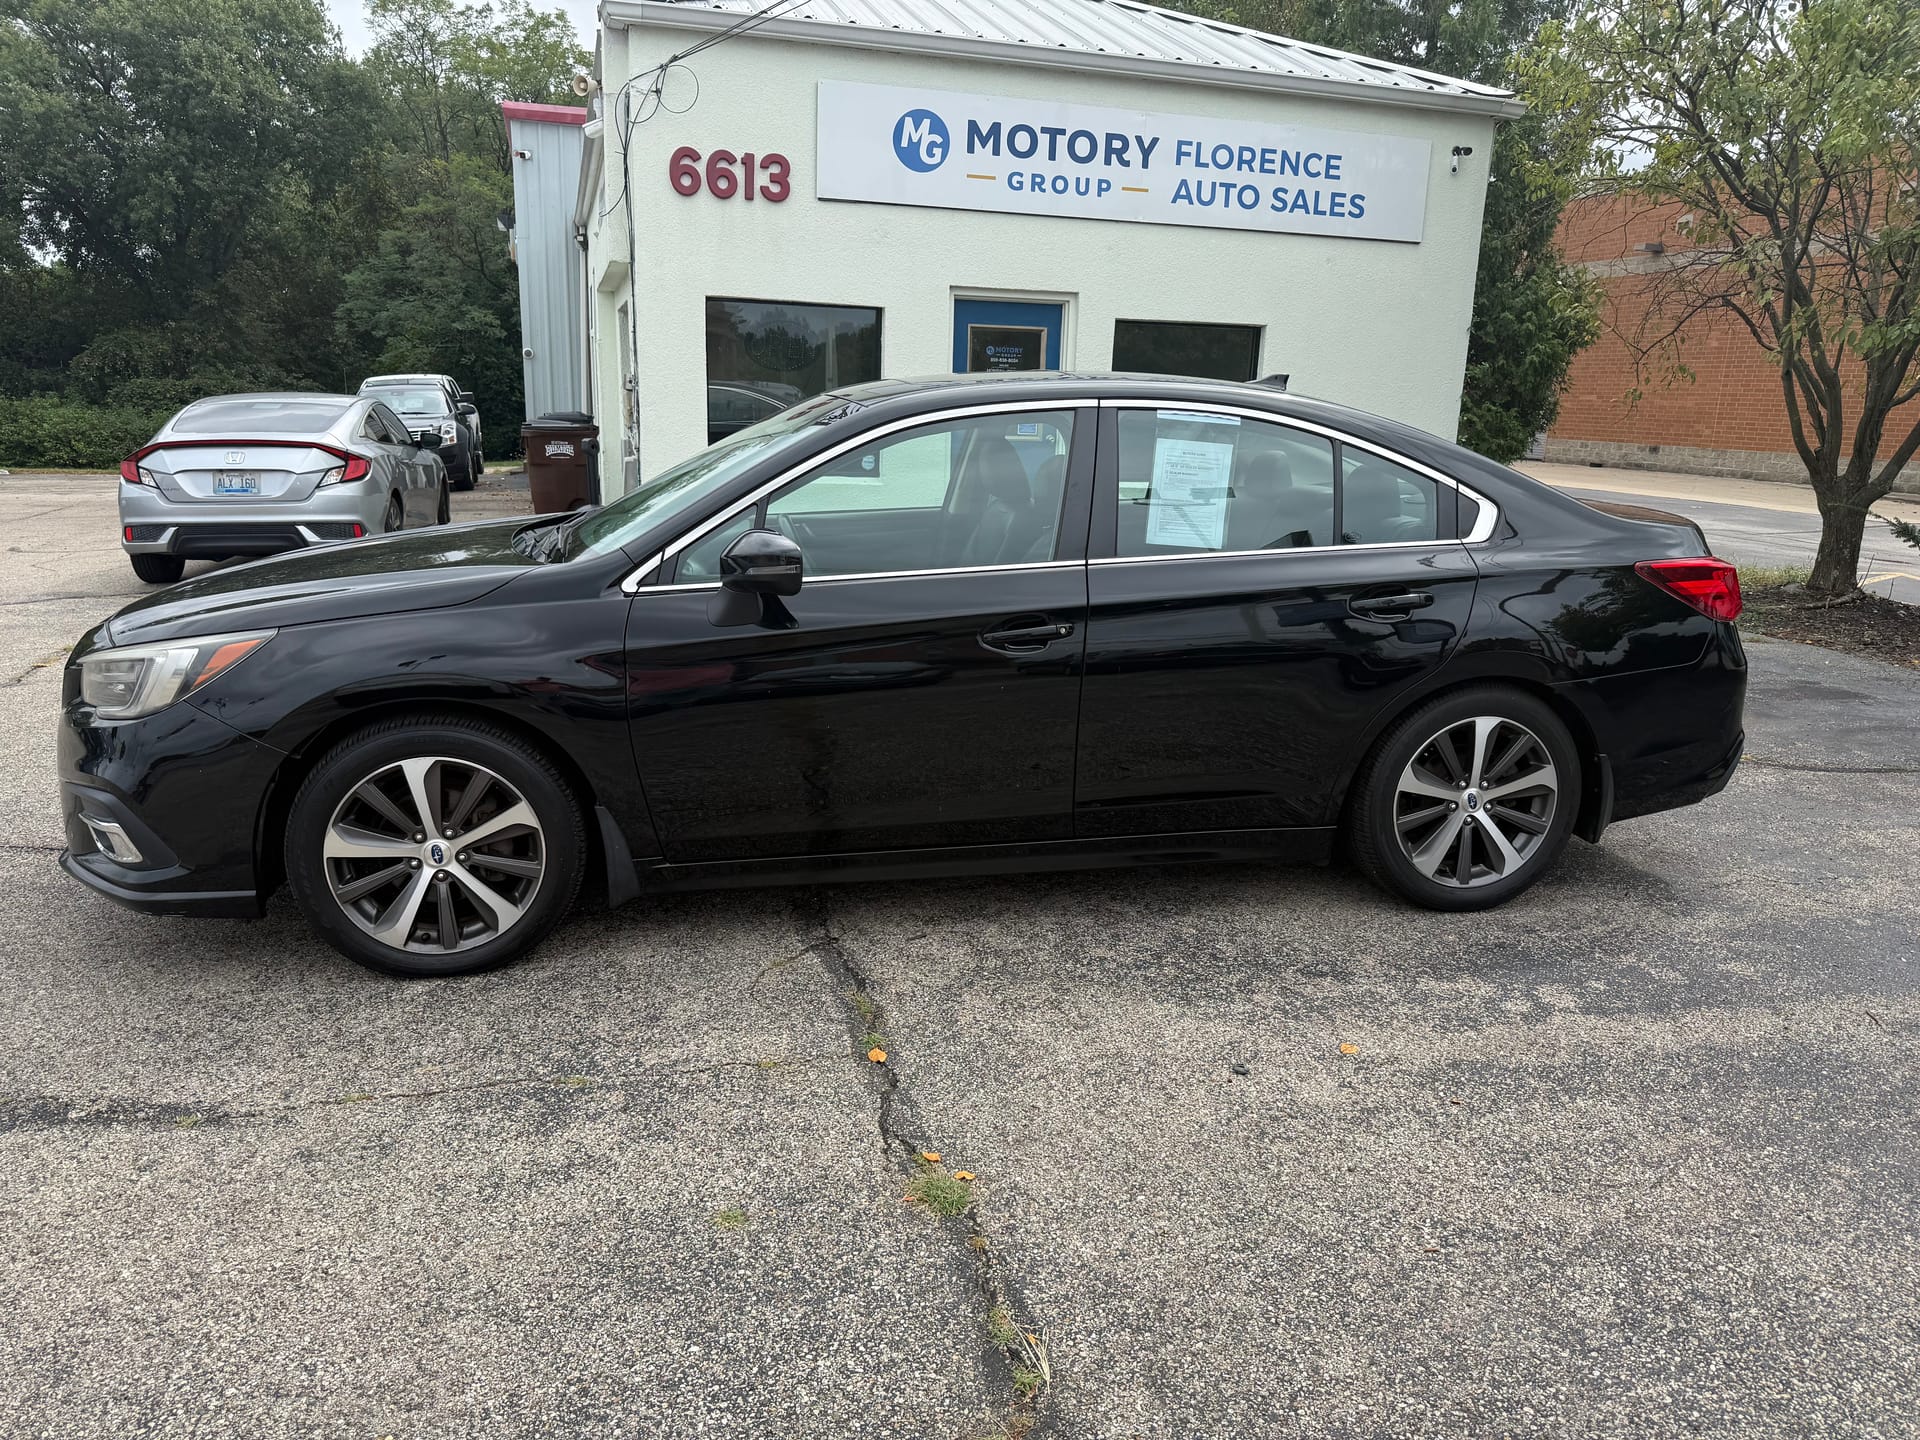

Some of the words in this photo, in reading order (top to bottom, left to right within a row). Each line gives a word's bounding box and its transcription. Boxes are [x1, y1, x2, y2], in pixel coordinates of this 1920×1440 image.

[900, 116, 943, 165] MG
[966, 119, 1160, 170] MOTORY
[1175, 139, 1343, 181] FLORENCE
[669, 146, 791, 203] 6613
[1007, 171, 1112, 198] GROUP
[1170, 178, 1260, 210] AUTO
[1270, 186, 1366, 219] SALES
